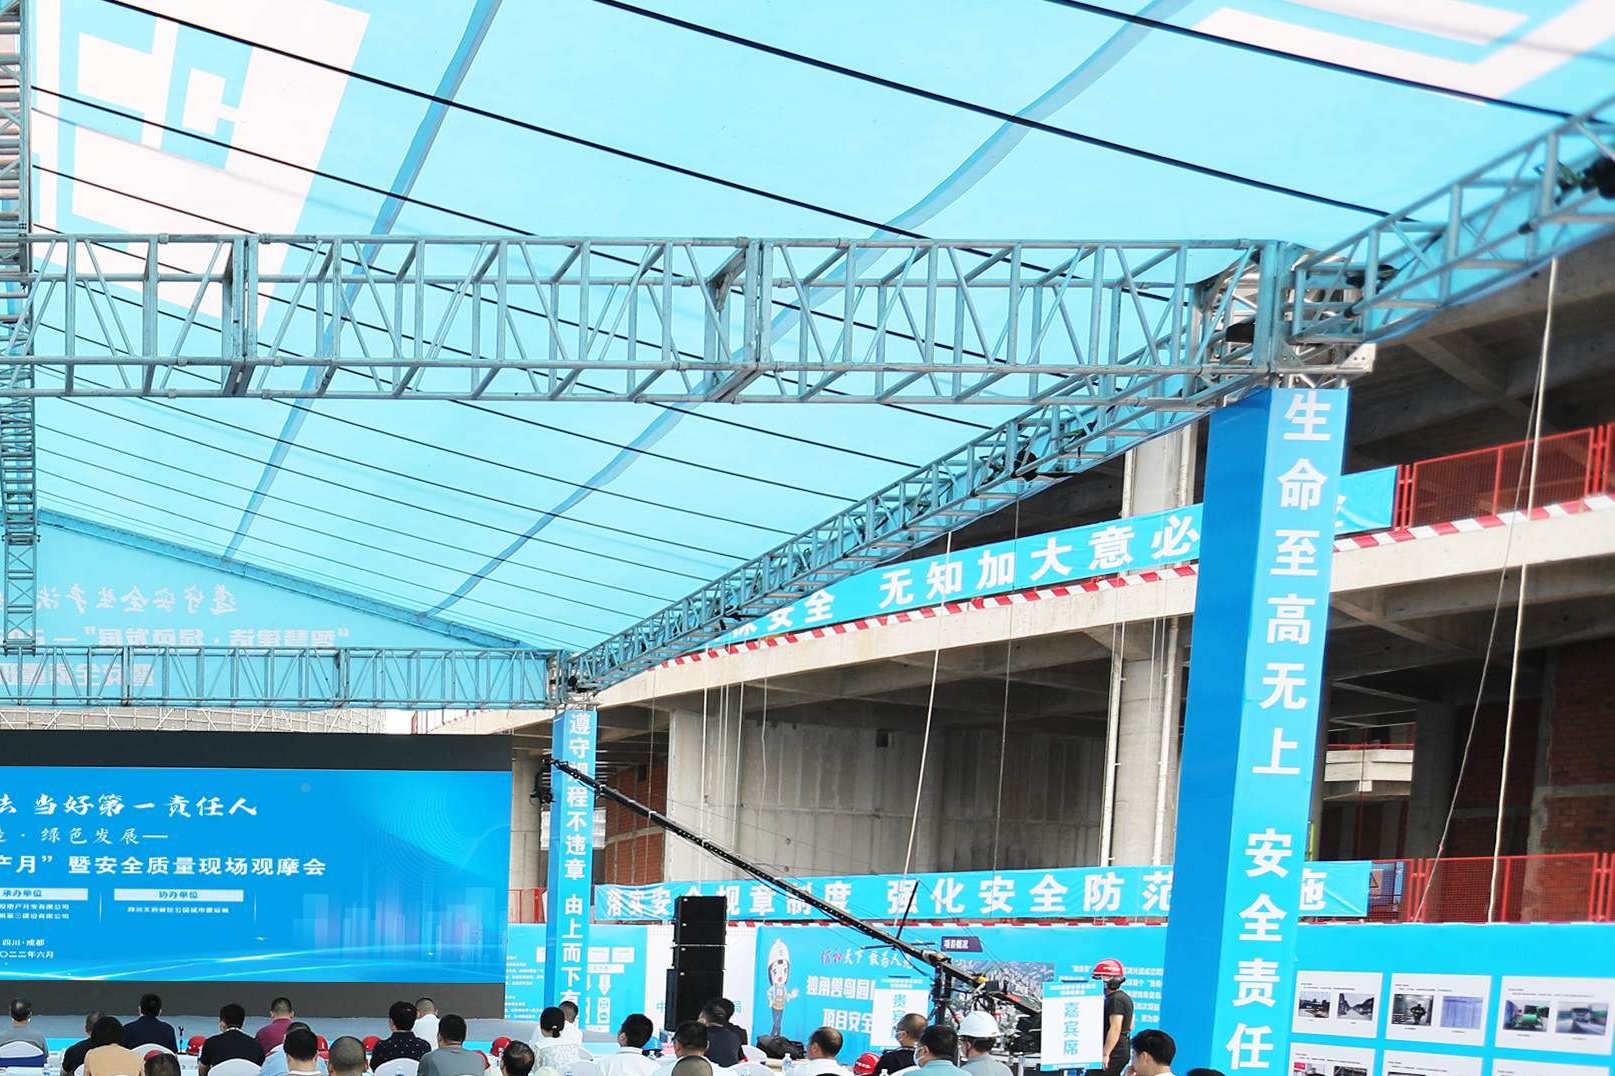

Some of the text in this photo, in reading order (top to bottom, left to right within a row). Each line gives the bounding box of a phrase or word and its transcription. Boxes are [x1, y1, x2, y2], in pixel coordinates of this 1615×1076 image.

[1252, 391, 1332, 774] 生命至高无上
[35, 793, 258, 818] 当好第一责任人
[2, 889, 42, 898] 承办单位
[158, 890, 199, 899] 协办单位
[2, 939, 45, 947] 四川·成都
[943, 939, 969, 950] 项目概况
[558, 893, 584, 1024] 由上而下有
[1063, 1002, 1079, 1055] 嘉宾席
